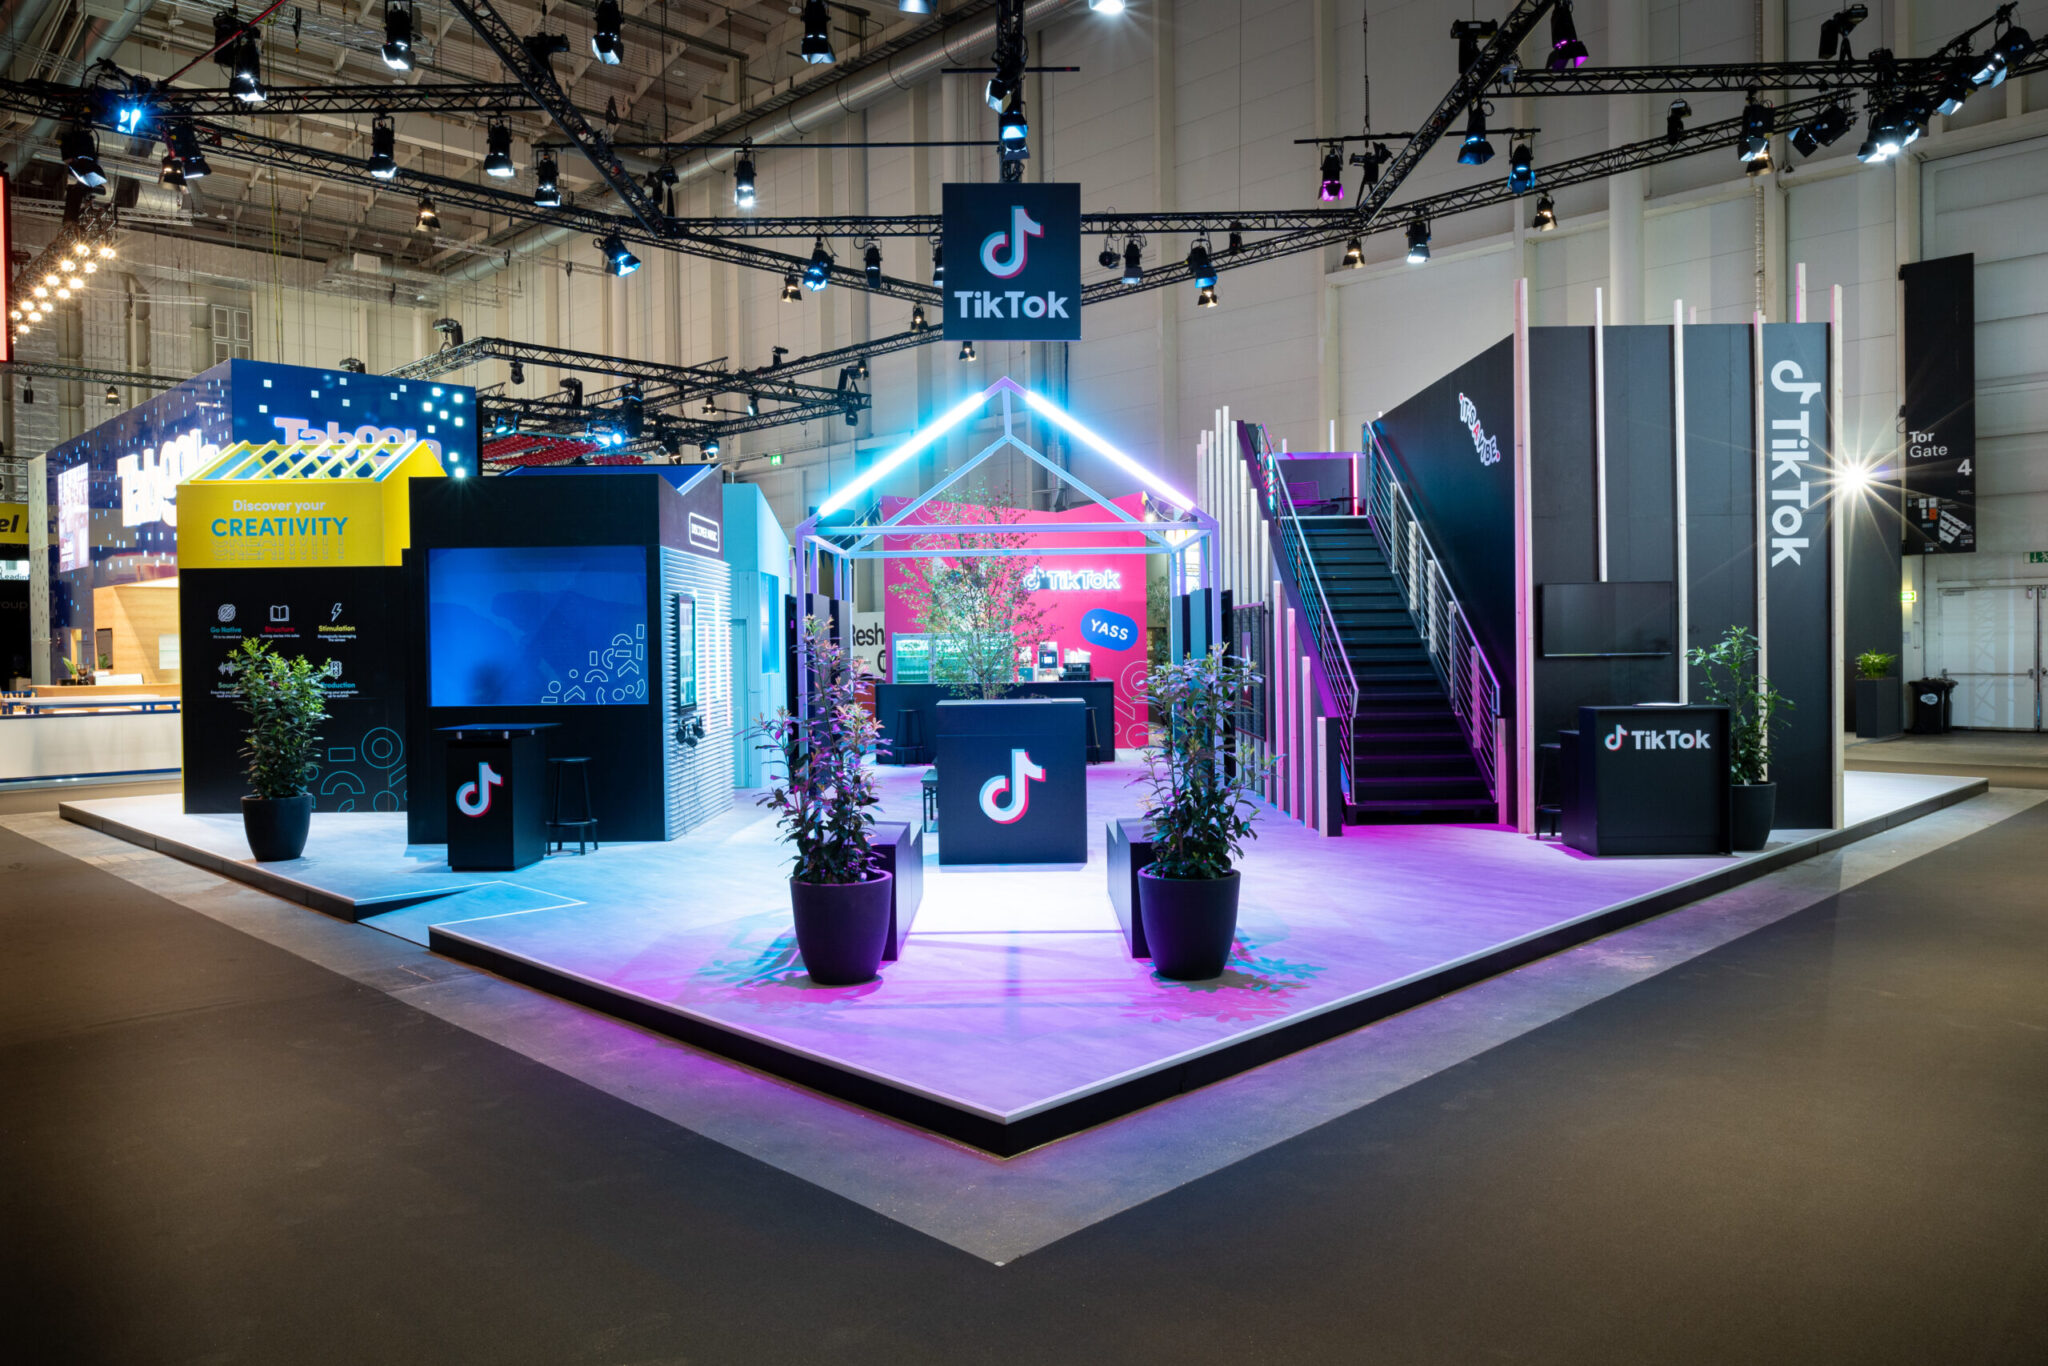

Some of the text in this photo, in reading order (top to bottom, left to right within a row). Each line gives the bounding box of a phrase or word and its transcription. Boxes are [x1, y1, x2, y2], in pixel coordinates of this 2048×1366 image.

[954, 291, 1069, 319] TikTok
[1909, 431, 1935, 443] Tor
[1910, 445, 1948, 458] Gate
[1957, 459, 1972, 476] 4
[1771, 411, 1809, 568] TikTok
[233, 500, 326, 514] Discover your
[211, 517, 348, 537] CREATIVITY
[1046, 569, 1121, 591] TikTok
[210, 626, 242, 634] Go Native
[264, 625, 295, 633] Structure
[1090, 618, 1129, 641] YASS
[1631, 729, 1711, 750] TikTok
